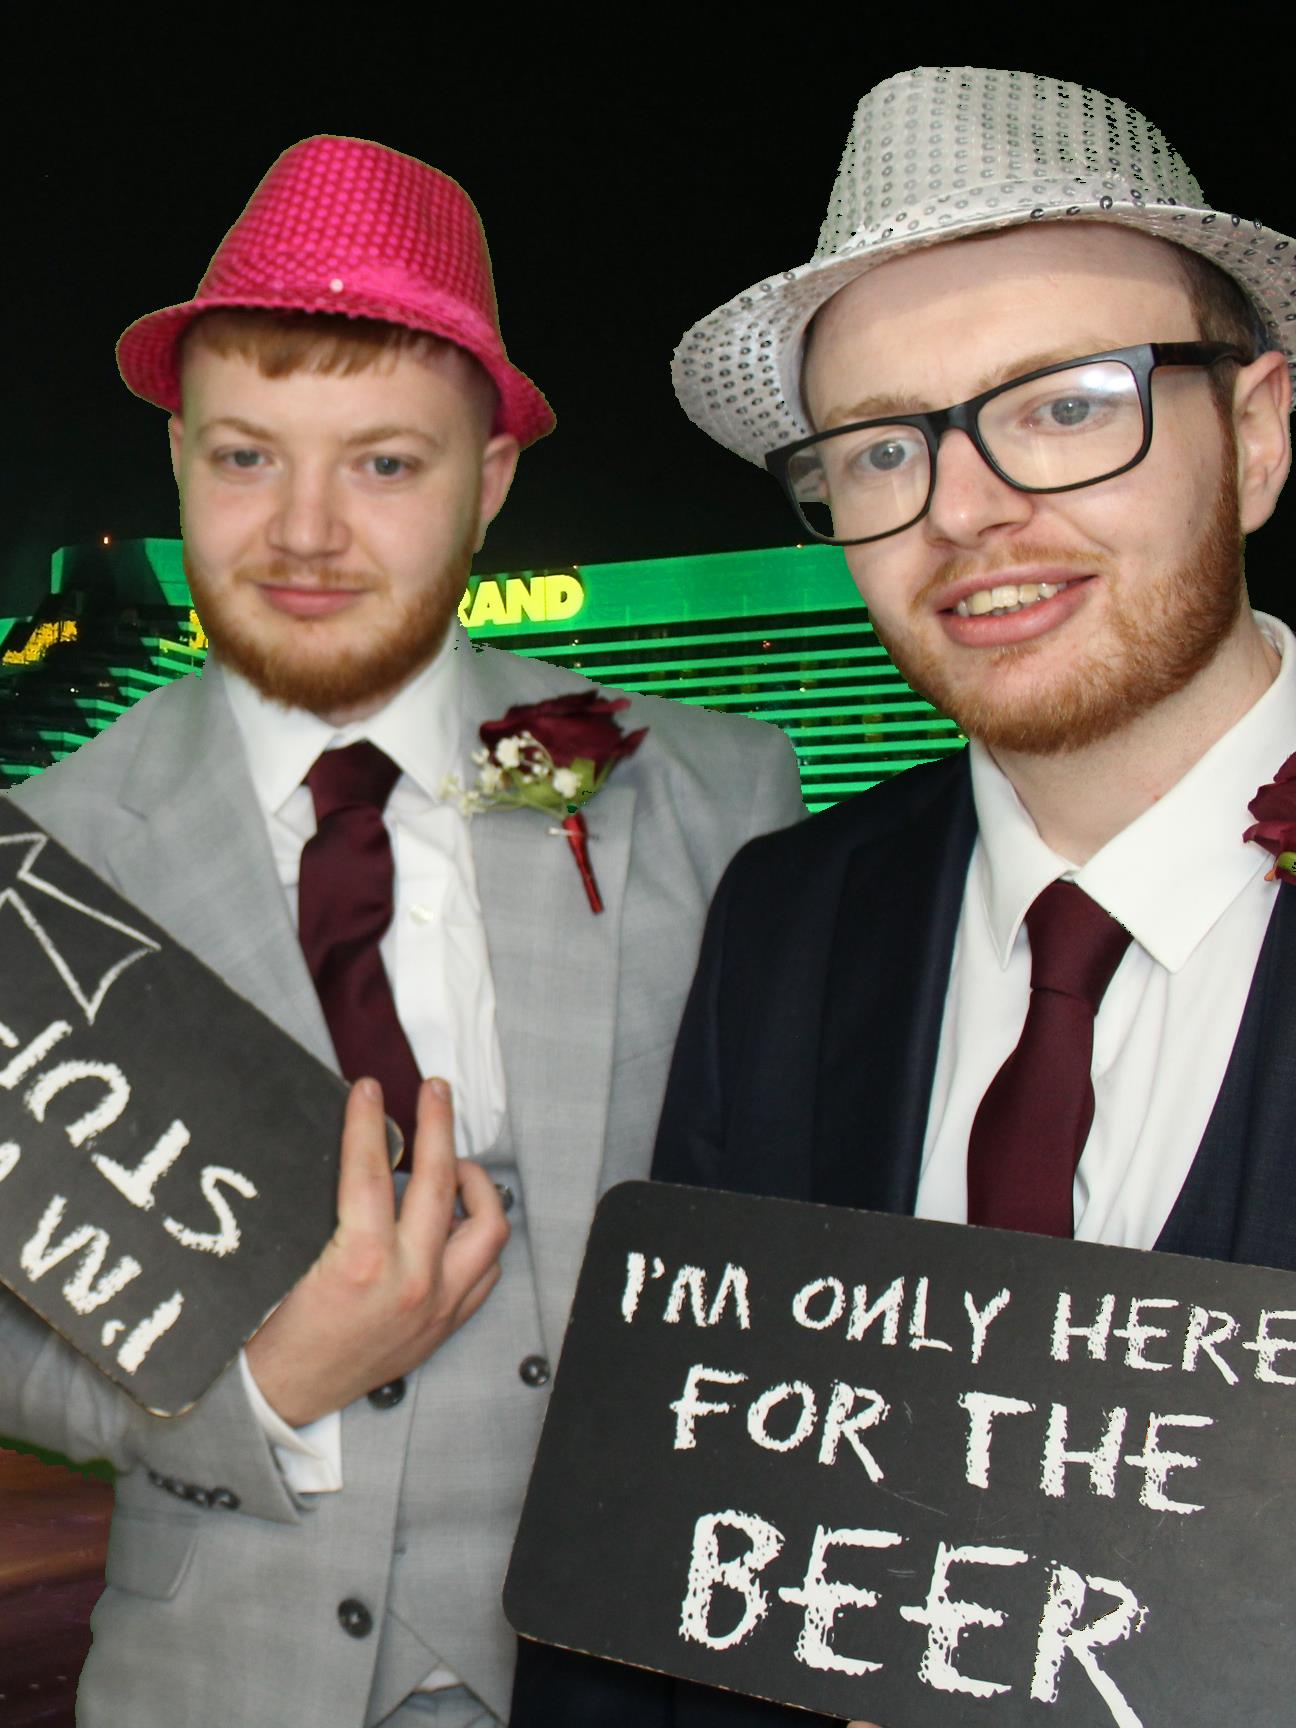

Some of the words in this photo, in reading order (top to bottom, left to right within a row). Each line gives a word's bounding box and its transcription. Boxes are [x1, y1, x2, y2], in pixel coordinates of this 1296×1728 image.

[20, 1194, 186, 1374] I'M
[621, 1252, 751, 1330] I'M
[792, 1276, 1011, 1364] ONLY
[1049, 1292, 1296, 1386] HERE
[669, 1363, 892, 1483] FOR
[957, 1390, 1215, 1515] THE
[678, 1508, 1151, 1728] BEER
